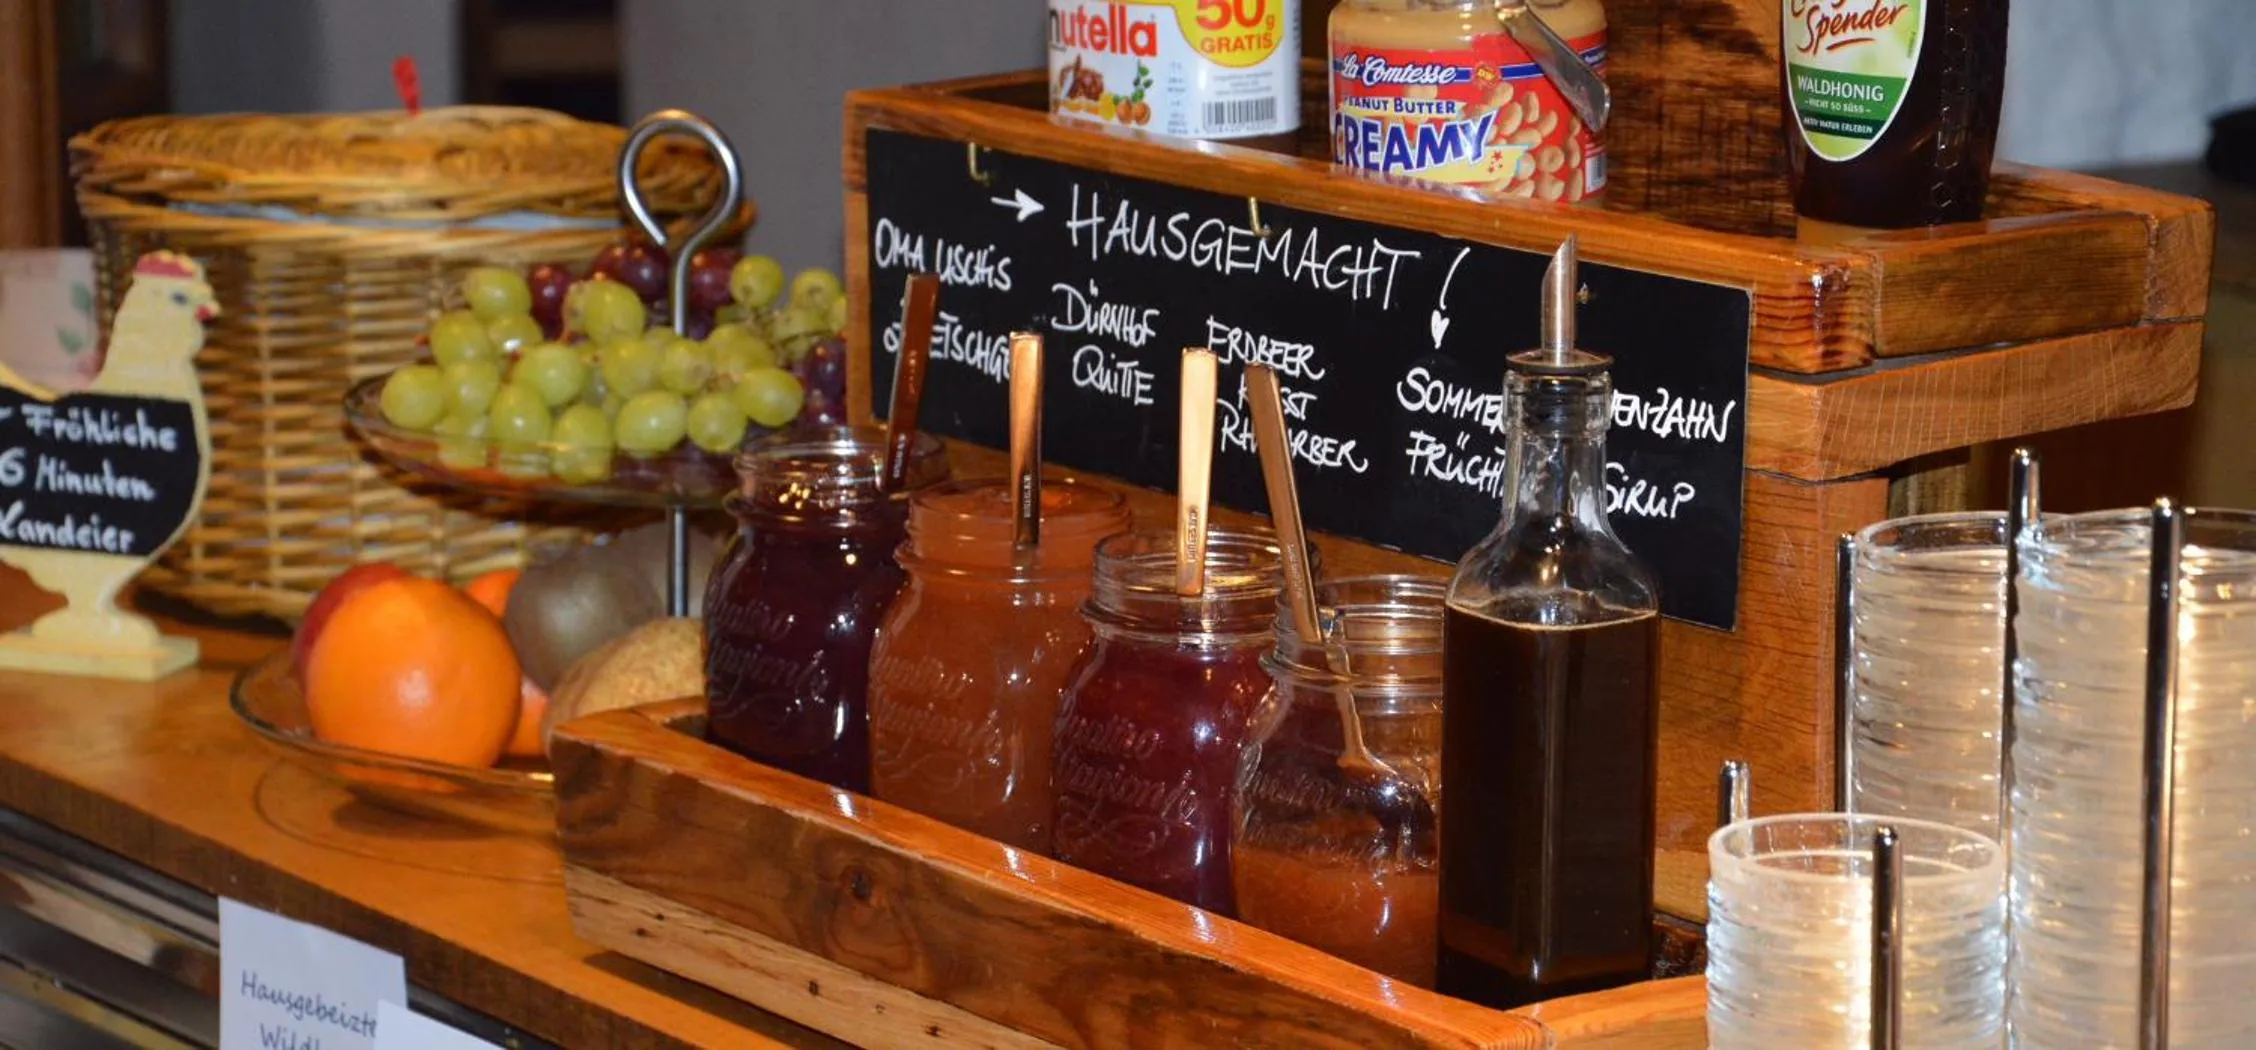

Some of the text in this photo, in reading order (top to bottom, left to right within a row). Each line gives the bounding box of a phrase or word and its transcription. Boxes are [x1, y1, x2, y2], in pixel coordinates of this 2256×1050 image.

[1049, 1, 1158, 57] nutella
[1199, 32, 1274, 55] GRATIS
[1796, 0, 1908, 56] Spender
[1341, 51, 1457, 85] La Comtesse
[1797, 75, 1884, 102] WALDHONIG
[1393, 97, 1457, 114] BUTTER
[1335, 112, 1495, 172] CREAMY
[875, 217, 926, 272] OMA
[1066, 183, 1422, 311] HAUSGEMACHT
[1206, 315, 1326, 381] ERDBEER
[21, 403, 178, 453] Fröhliche
[1216, 397, 1369, 473] RHRBER
[0, 447, 157, 501] 6 Minuten
[1405, 430, 1506, 499] FRÜCHT
